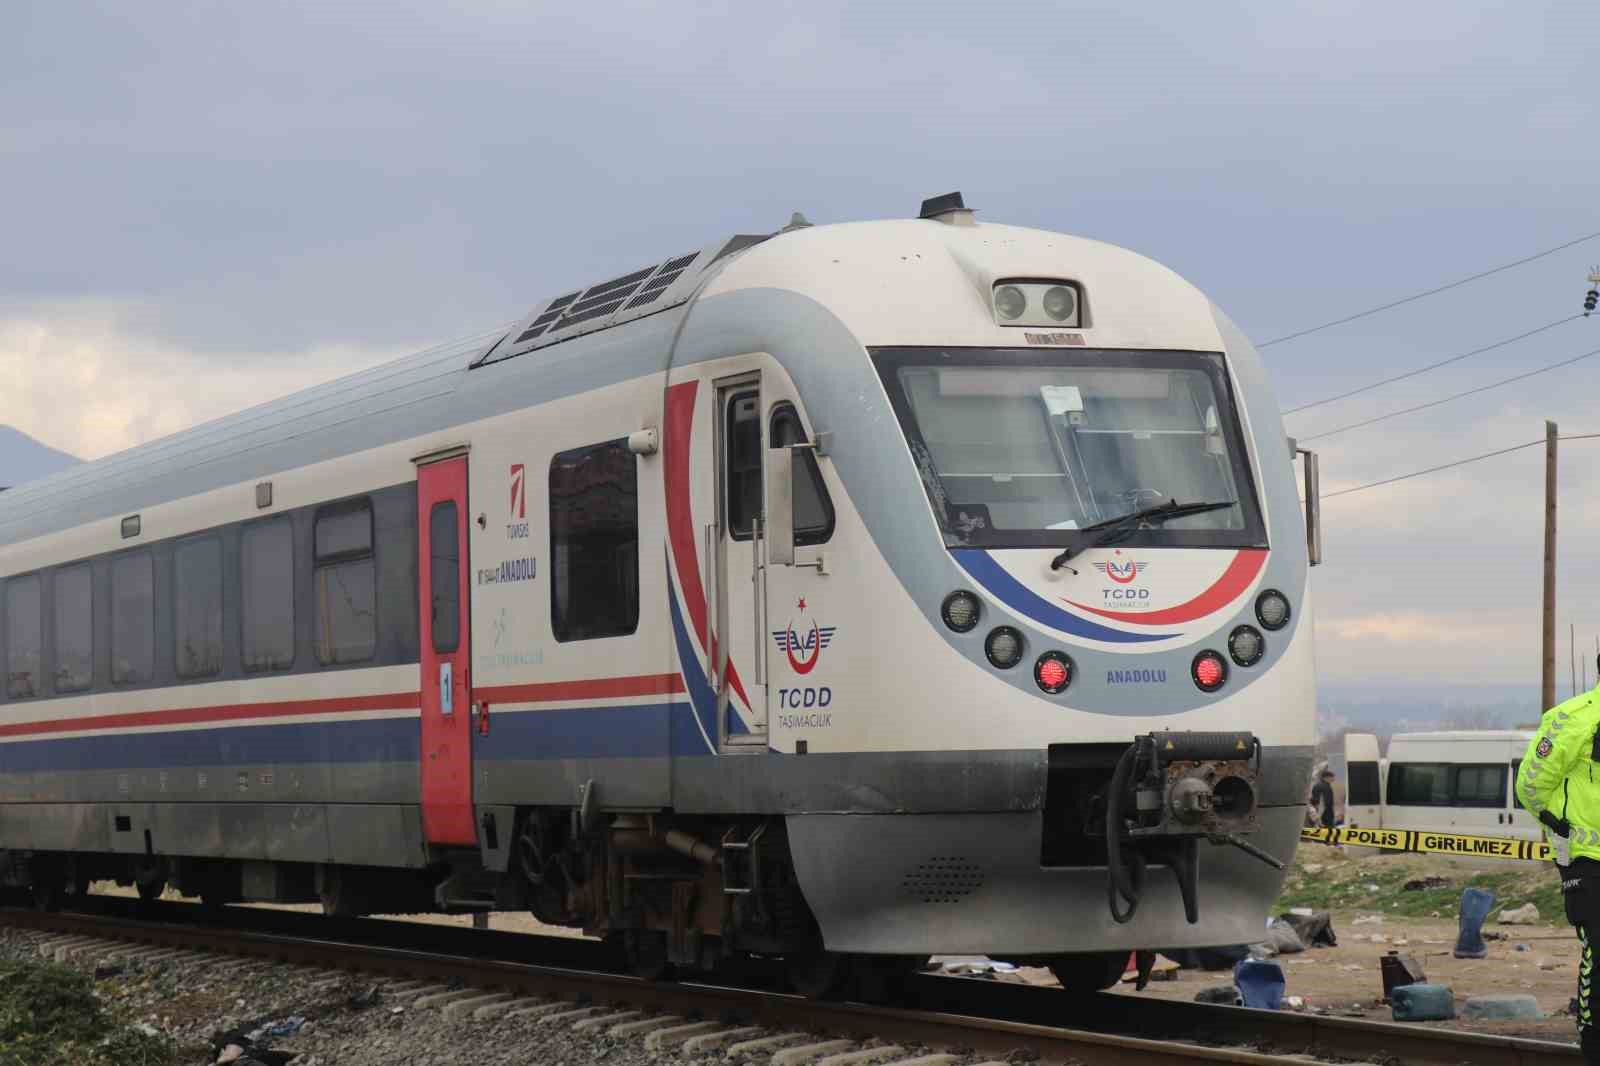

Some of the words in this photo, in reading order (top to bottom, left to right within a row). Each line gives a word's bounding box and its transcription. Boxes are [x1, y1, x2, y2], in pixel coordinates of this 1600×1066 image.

[500, 556, 537, 584] ANADOLU
[1102, 588, 1150, 599] TCDD
[1106, 669, 1167, 684] ANADOLU
[778, 687, 832, 709] TCDD
[1345, 830, 1398, 846] POLİS
[1424, 836, 1513, 856] GİRİLMEZ
